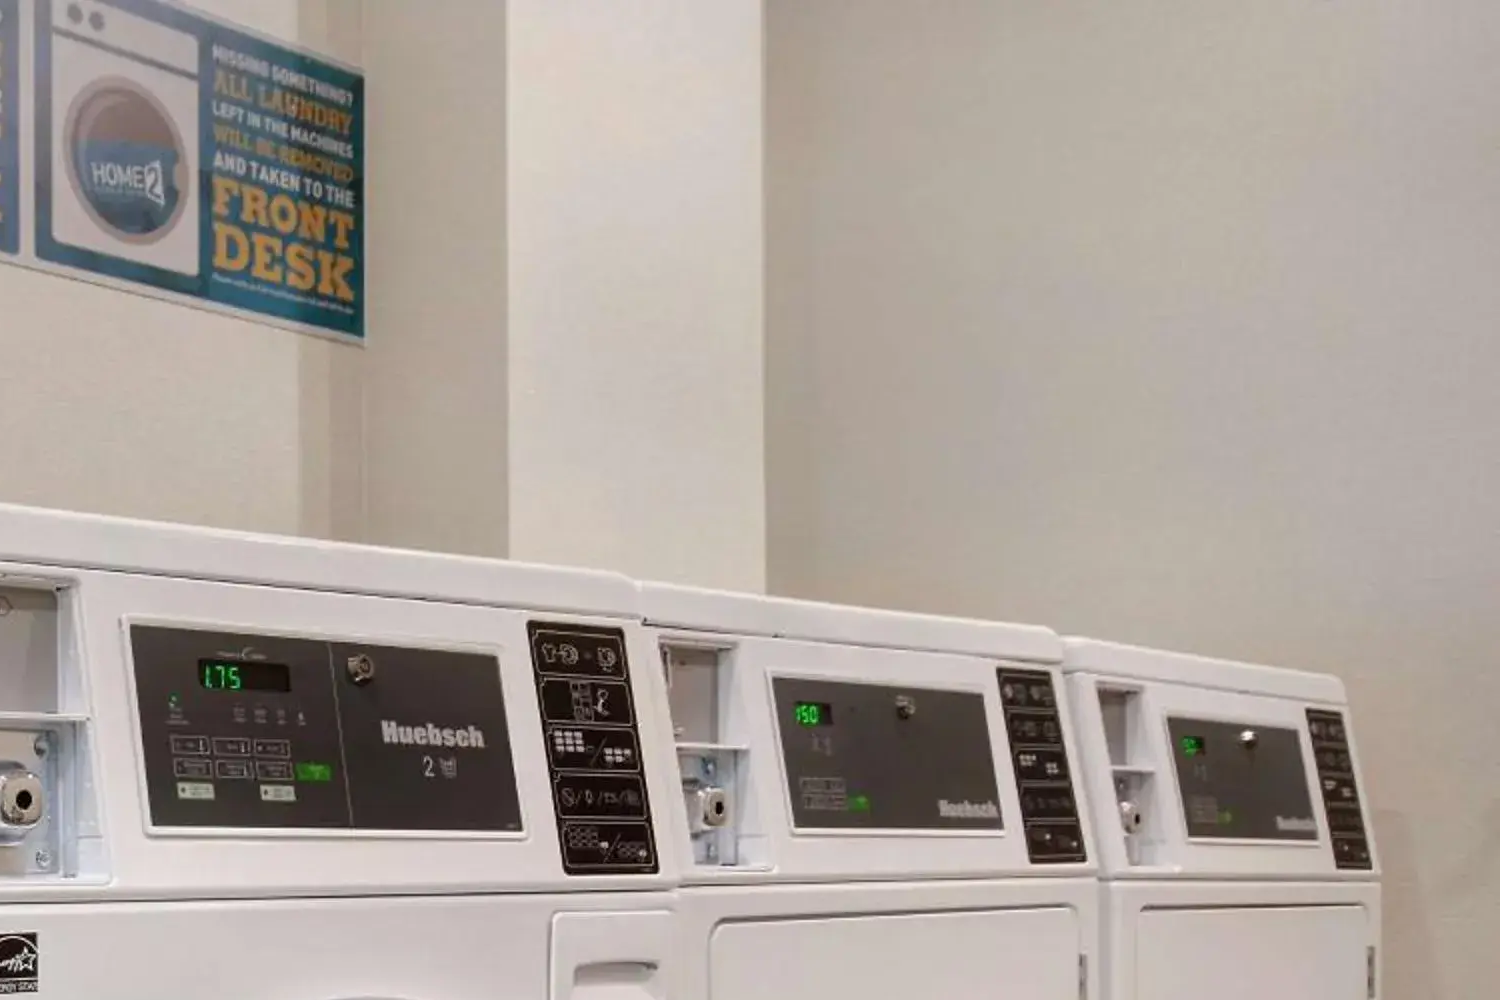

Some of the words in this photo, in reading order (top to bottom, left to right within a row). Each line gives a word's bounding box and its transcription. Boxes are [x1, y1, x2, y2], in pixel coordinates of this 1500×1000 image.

[213, 70, 249, 99] ALL
[259, 84, 353, 134] LAUNDRY
[213, 99, 245, 122] LEFT
[247, 111, 261, 128] IN
[264, 116, 289, 138] THE
[291, 125, 353, 158] MACHINES
[213, 150, 246, 176] AND
[249, 160, 300, 192] TAKEN
[303, 177, 323, 199] TO
[325, 183, 356, 209] THE
[212, 175, 354, 249] FRONT
[212, 221, 354, 301] DESK
[205, 665, 241, 689] 1.75
[381, 720, 486, 748] Huebsch
[422, 756, 435, 777] 2
